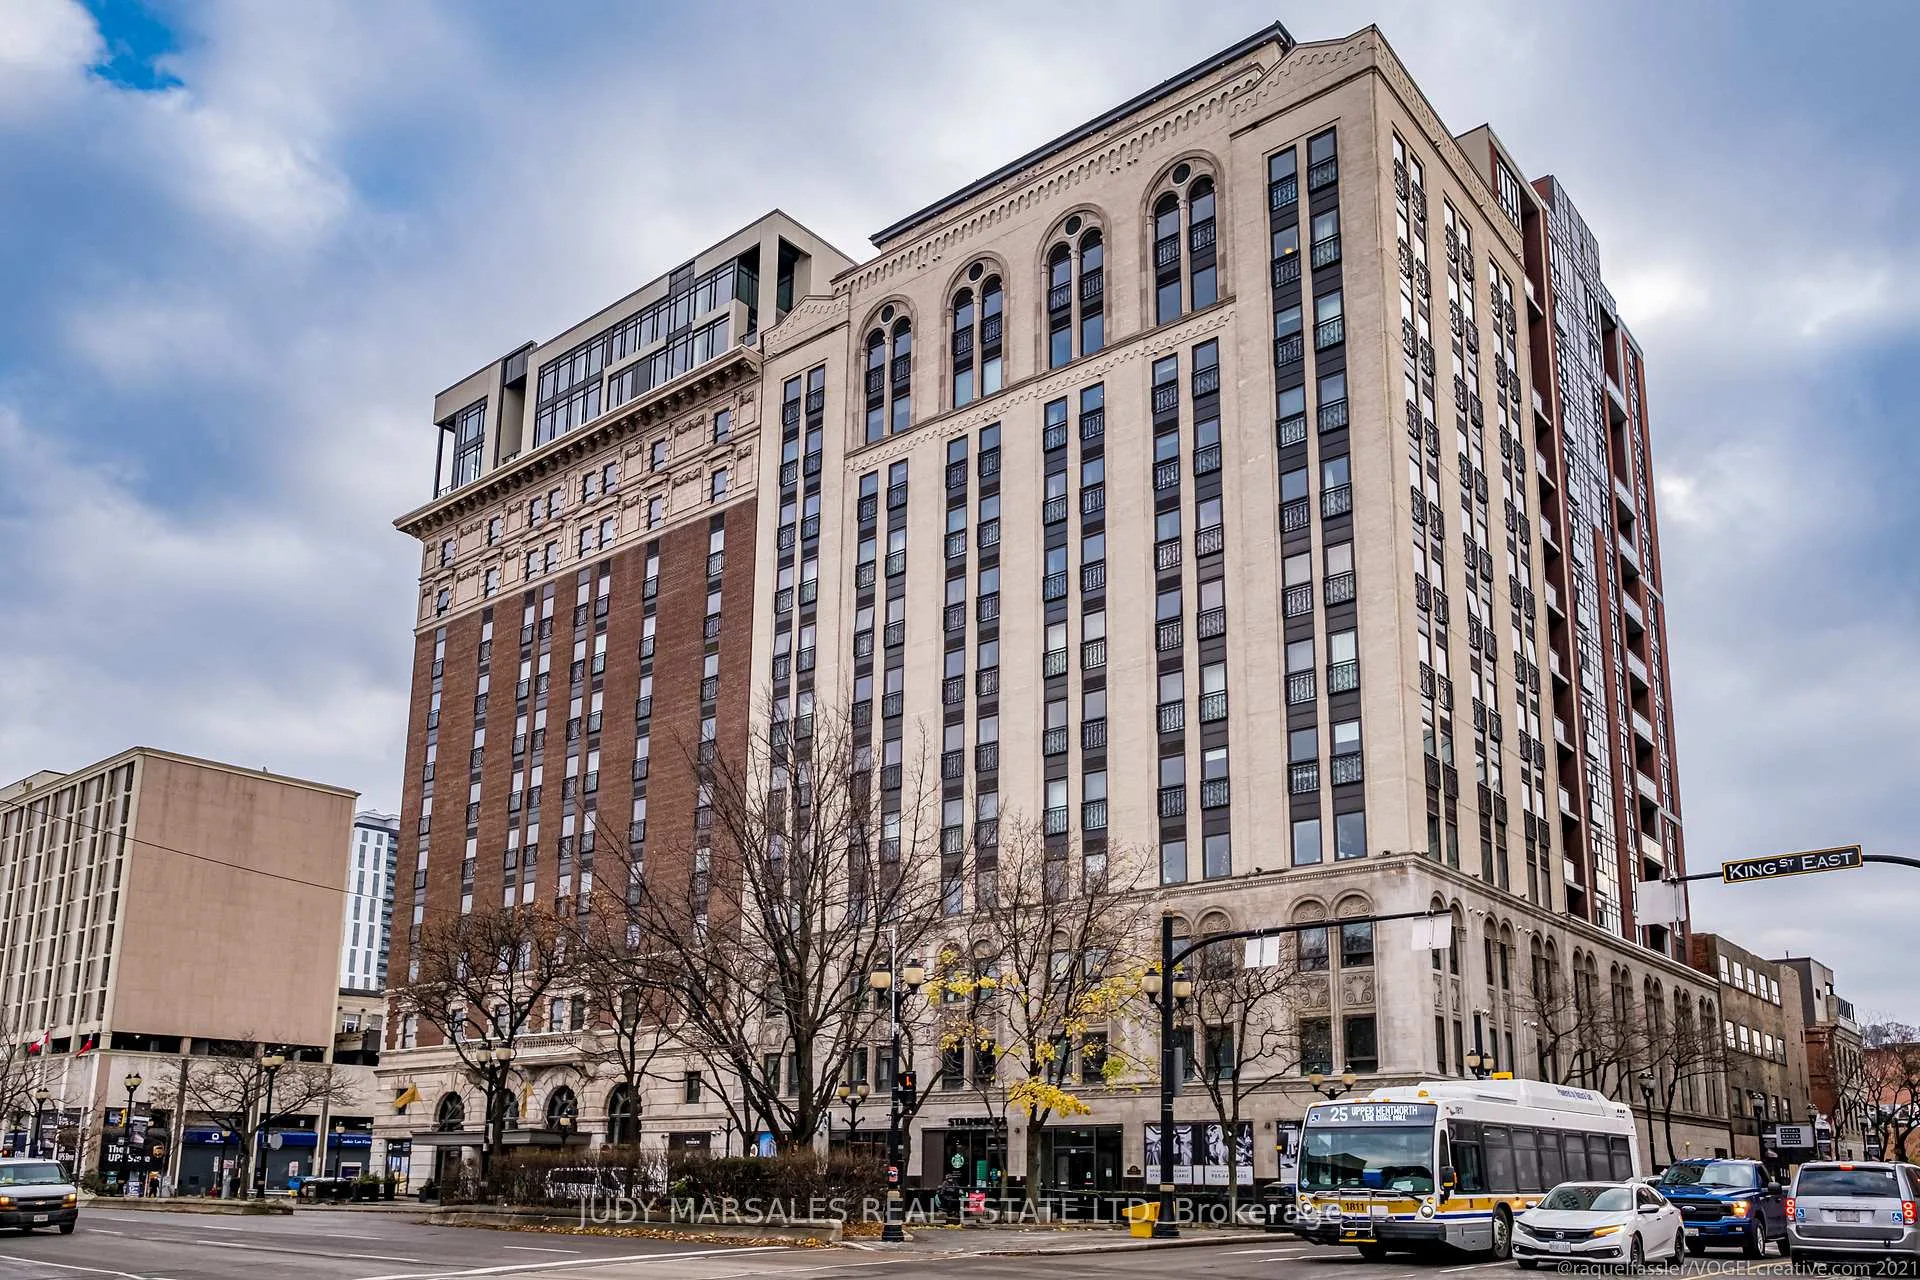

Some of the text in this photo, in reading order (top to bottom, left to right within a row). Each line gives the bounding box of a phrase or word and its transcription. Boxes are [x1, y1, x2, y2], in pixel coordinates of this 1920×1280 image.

[1330, 1105, 1418, 1122] 25 UPPER WENTWORTH
[1344, 1202, 1364, 1211] 1811
